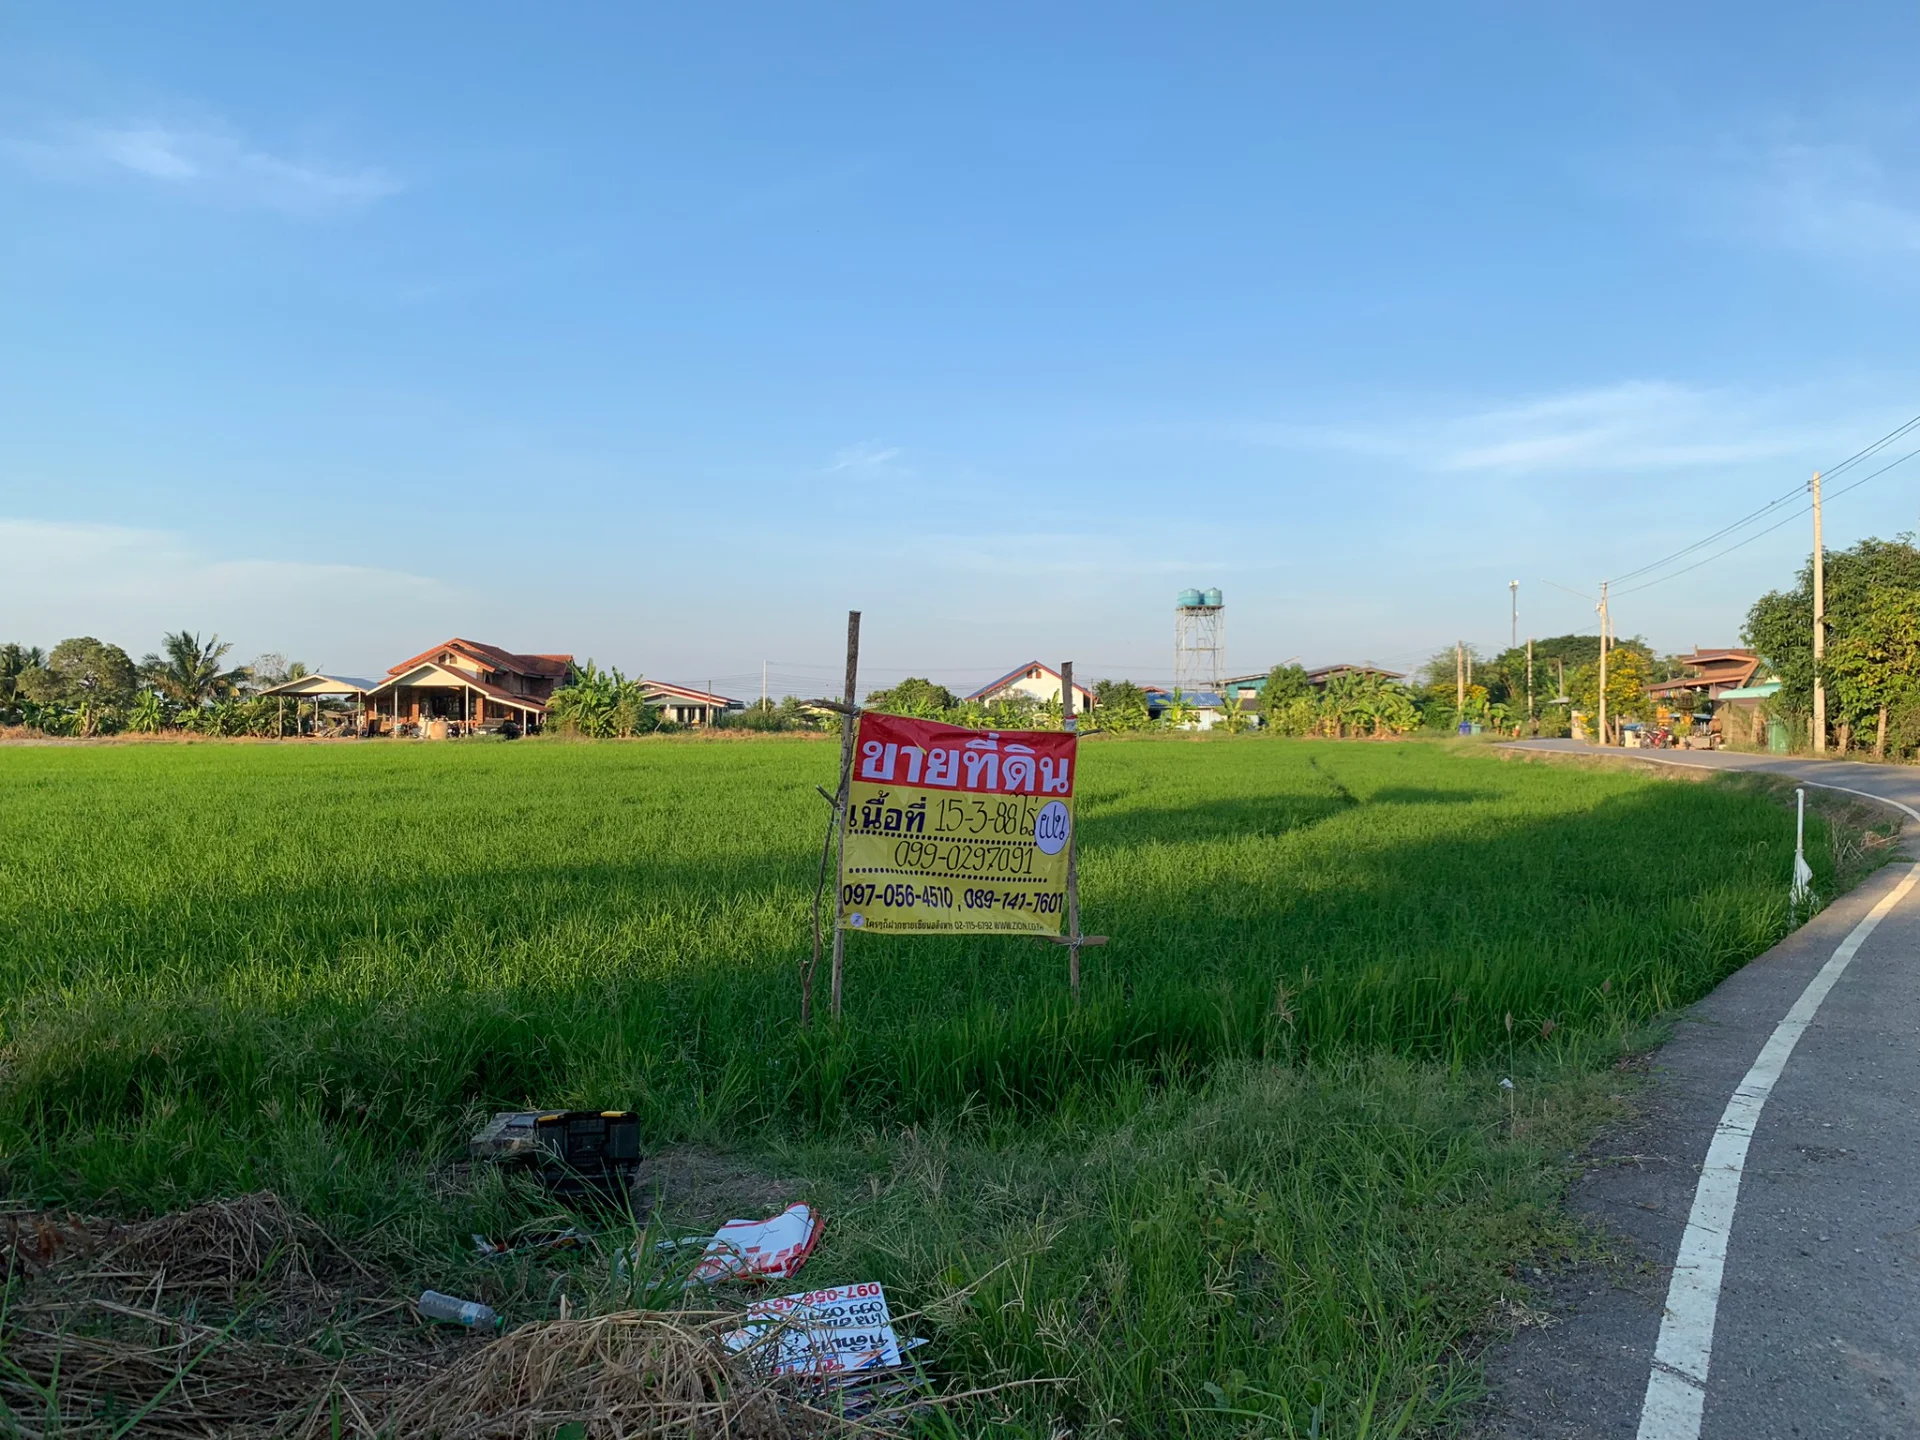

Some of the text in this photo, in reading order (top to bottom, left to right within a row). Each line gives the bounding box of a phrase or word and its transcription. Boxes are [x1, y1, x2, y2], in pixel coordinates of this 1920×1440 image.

[862, 733, 1069, 793] ขายที่ดิน
[848, 790, 927, 833] เนื้อที่
[895, 840, 1033, 875] 099-0297091
[965, 888, 1064, 913] 089-141-7601
